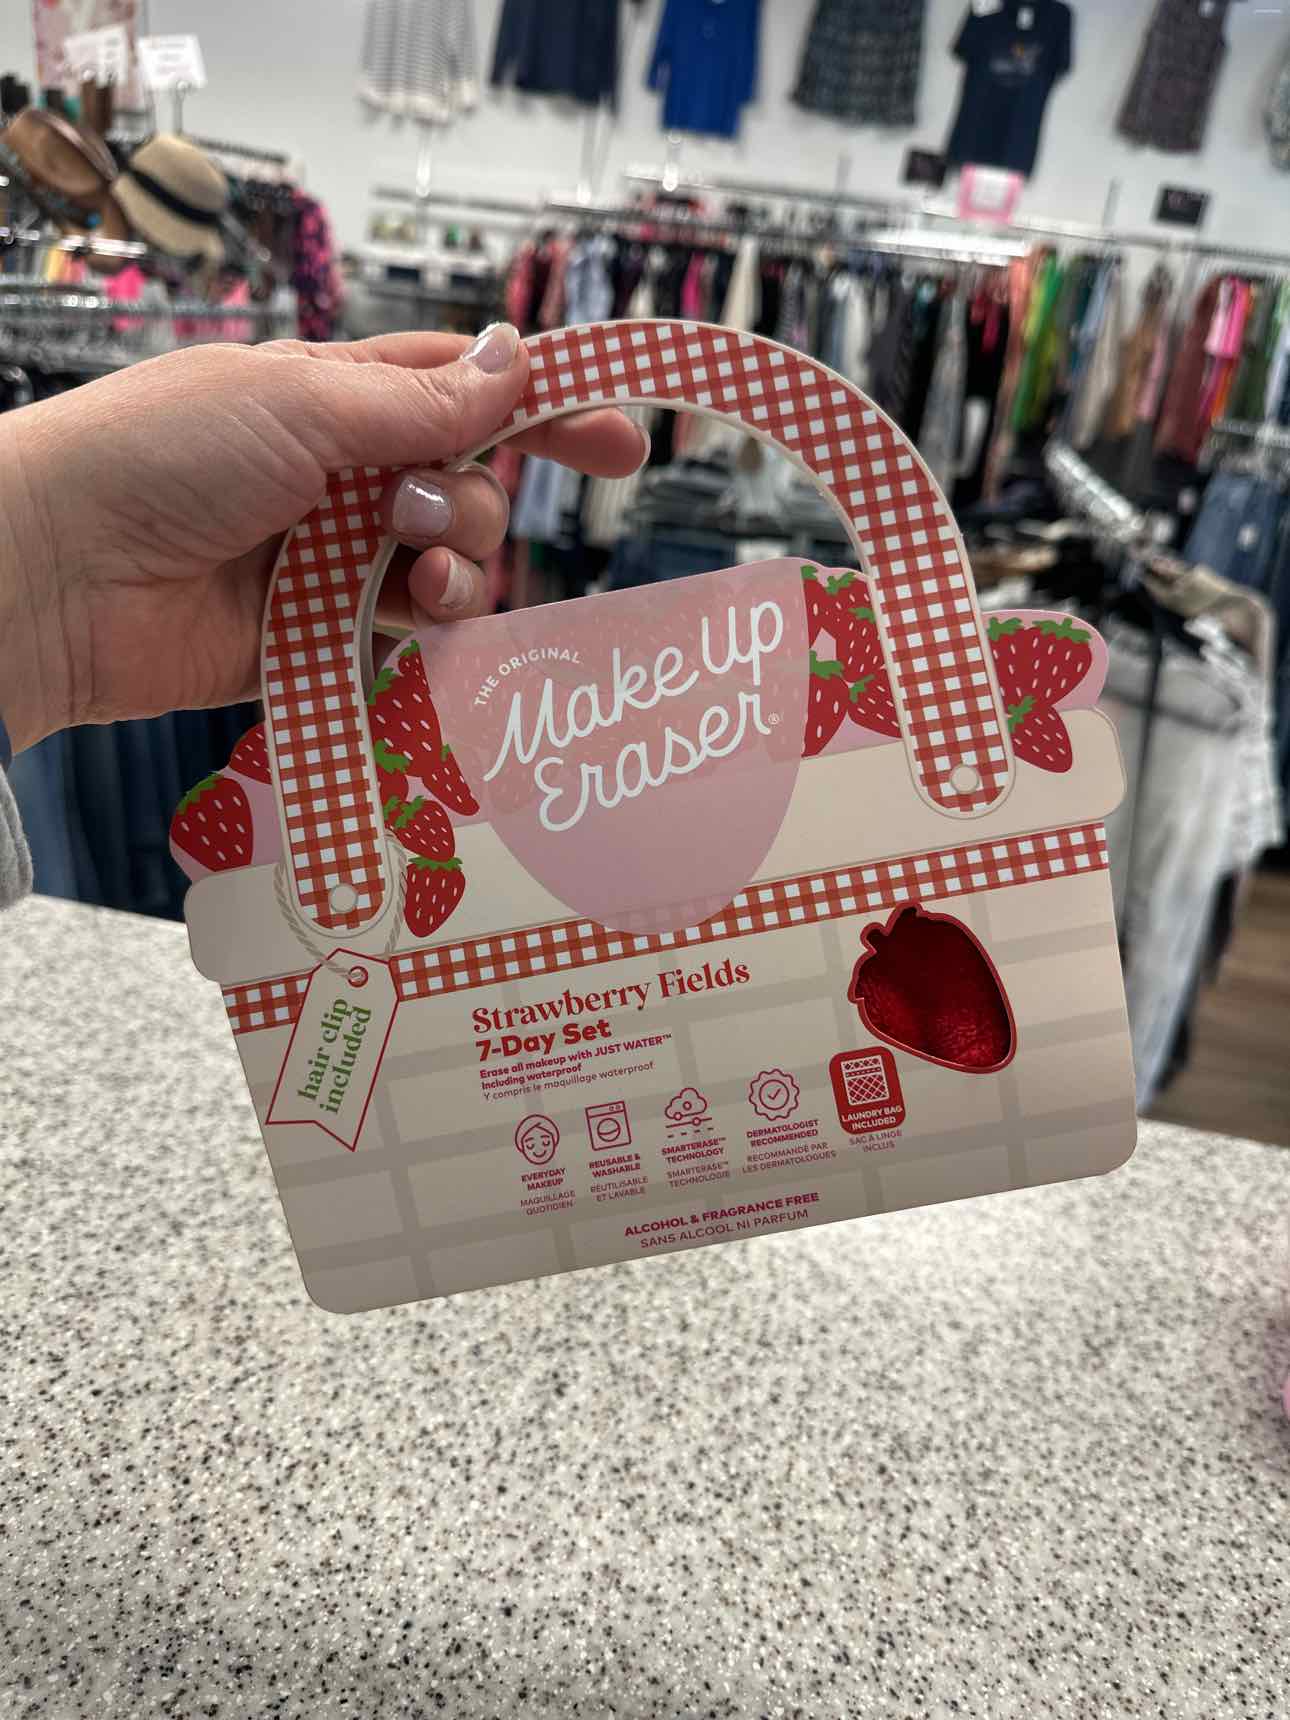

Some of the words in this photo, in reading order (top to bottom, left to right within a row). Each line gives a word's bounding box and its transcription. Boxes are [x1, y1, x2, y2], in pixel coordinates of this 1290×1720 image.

[474, 675, 500, 706] THE
[498, 647, 581, 677] ORIGINAL
[472, 982, 651, 1034] Strawberry
[657, 959, 750, 998] Fields
[475, 1032, 556, 1061] 7-Day
[562, 1018, 612, 1045] Set
[297, 1046, 330, 1101] hair
[321, 998, 352, 1043] clip
[319, 1006, 372, 1114] included
[480, 1067, 509, 1080] Erase
[511, 1061, 524, 1073] all
[526, 1055, 566, 1072] makeup
[568, 1050, 592, 1063] with
[594, 1043, 621, 1057] JUST
[482, 1073, 525, 1090] Including
[527, 1063, 583, 1082] waterproof
[483, 1093, 491, 1101] Y
[492, 1085, 531, 1100] compris
[533, 1083, 541, 1092] le
[544, 1072, 597, 1089] maquillage
[598, 1061, 656, 1078] waterproof
[841, 1108, 882, 1122] LAUNDRY
[883, 1105, 903, 1116] BAG
[746, 1119, 819, 1138] DERMATOLOGIST
[852, 1116, 896, 1130] INCLUDED
[750, 1129, 818, 1148] RECOMMENDED
[811, 1141, 828, 1151] PAR
[849, 1135, 867, 1145] SAC
[863, 1140, 895, 1152] INCLUS
[589, 1154, 633, 1168] REUSABLE
[665, 1147, 724, 1164] TECHNOLOGY
[742, 1164, 758, 1174] LES
[760, 1150, 837, 1170] DERMATOLOGUES
[521, 1167, 566, 1182] EVERYDAY
[592, 1162, 641, 1178] WASHABLE
[669, 1170, 730, 1188] TECHNOLOGIE
[527, 1177, 564, 1191] MAKEUP
[608, 1186, 646, 1200] LAVABLE
[520, 1190, 576, 1207] MAQUILLAGE
[526, 1200, 574, 1216] QUOTIDIEN
[624, 1216, 688, 1237] ALCOHOL
[690, 1214, 700, 1224] &
[702, 1198, 783, 1222] FRAGRANCE
[785, 1192, 820, 1207] FREE
[640, 1233, 676, 1249] SANS
[679, 1223, 734, 1241] ALCOOL
[736, 1220, 751, 1231] NI
[753, 1209, 809, 1228] PARFUM
